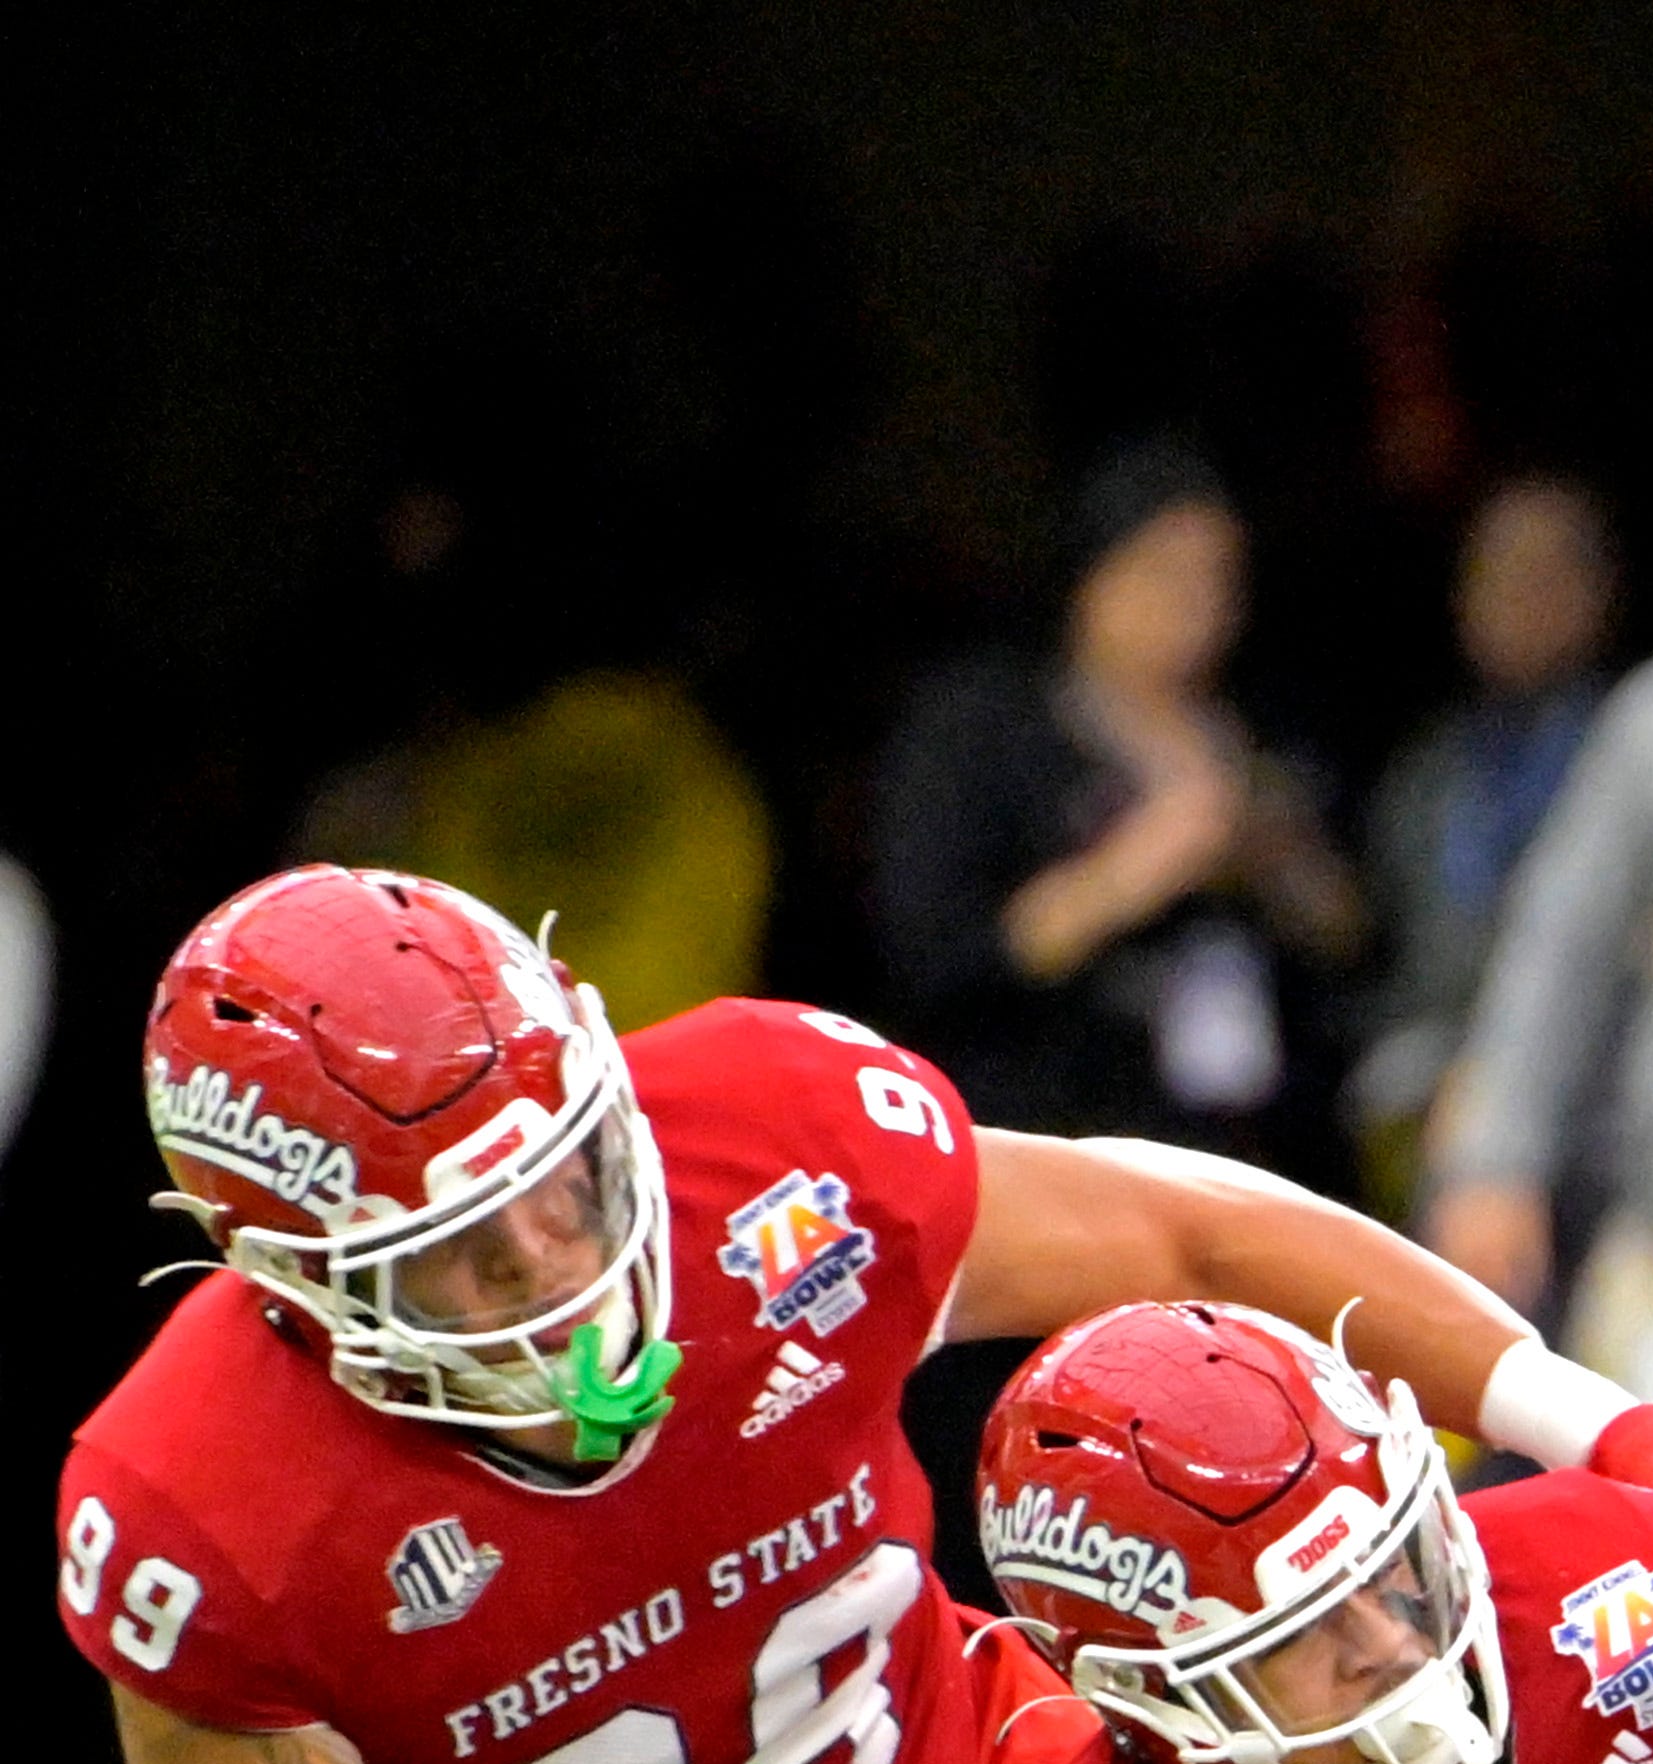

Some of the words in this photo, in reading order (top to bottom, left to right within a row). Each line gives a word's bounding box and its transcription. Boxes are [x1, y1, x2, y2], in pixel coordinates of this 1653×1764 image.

[740, 1361, 846, 1438] adidas
[58, 1495, 204, 1672] 99
[445, 1587, 687, 1759] FRESNO
[707, 1462, 877, 1609] STATE
